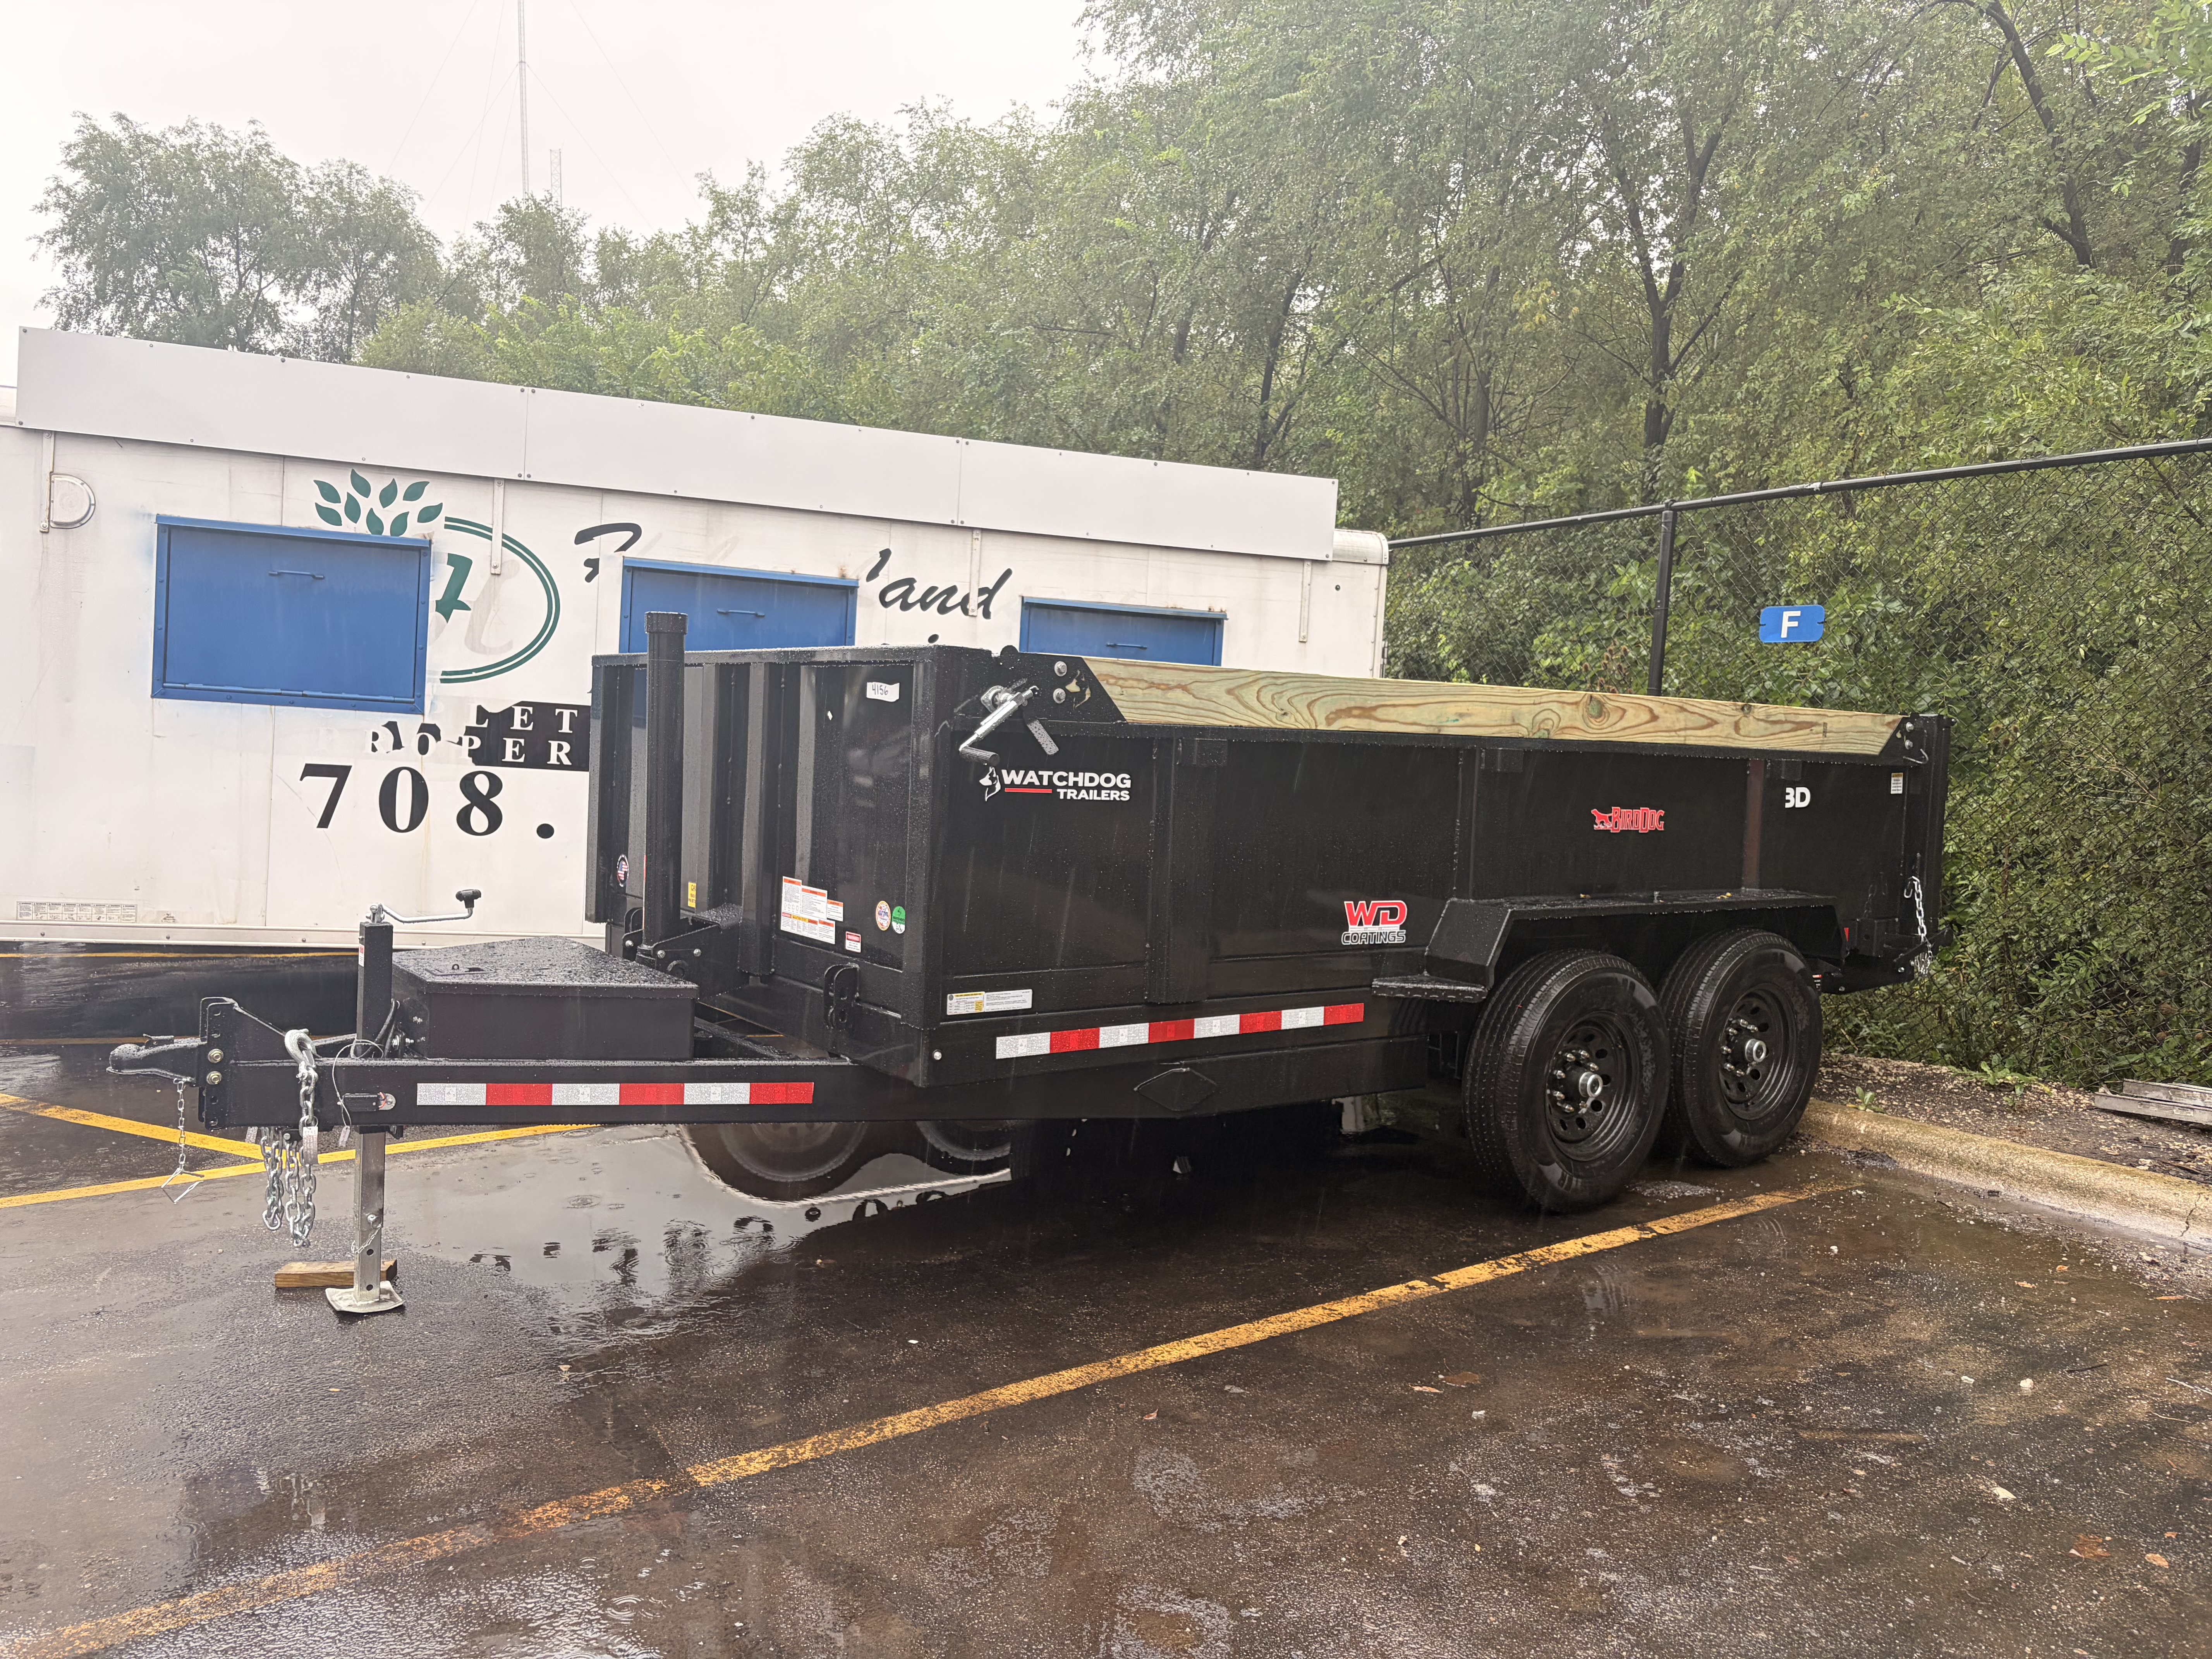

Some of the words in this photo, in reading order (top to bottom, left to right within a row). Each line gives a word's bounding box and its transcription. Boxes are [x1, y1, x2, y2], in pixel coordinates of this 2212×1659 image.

[1781, 611, 1801, 638] F
[872, 683, 888, 696] 4156
[1001, 769, 1131, 788] WATCHDOG
[1057, 789, 1130, 801] TRAILERS
[1344, 900, 1407, 926] WD
[1341, 930, 1406, 945] COATINGS
